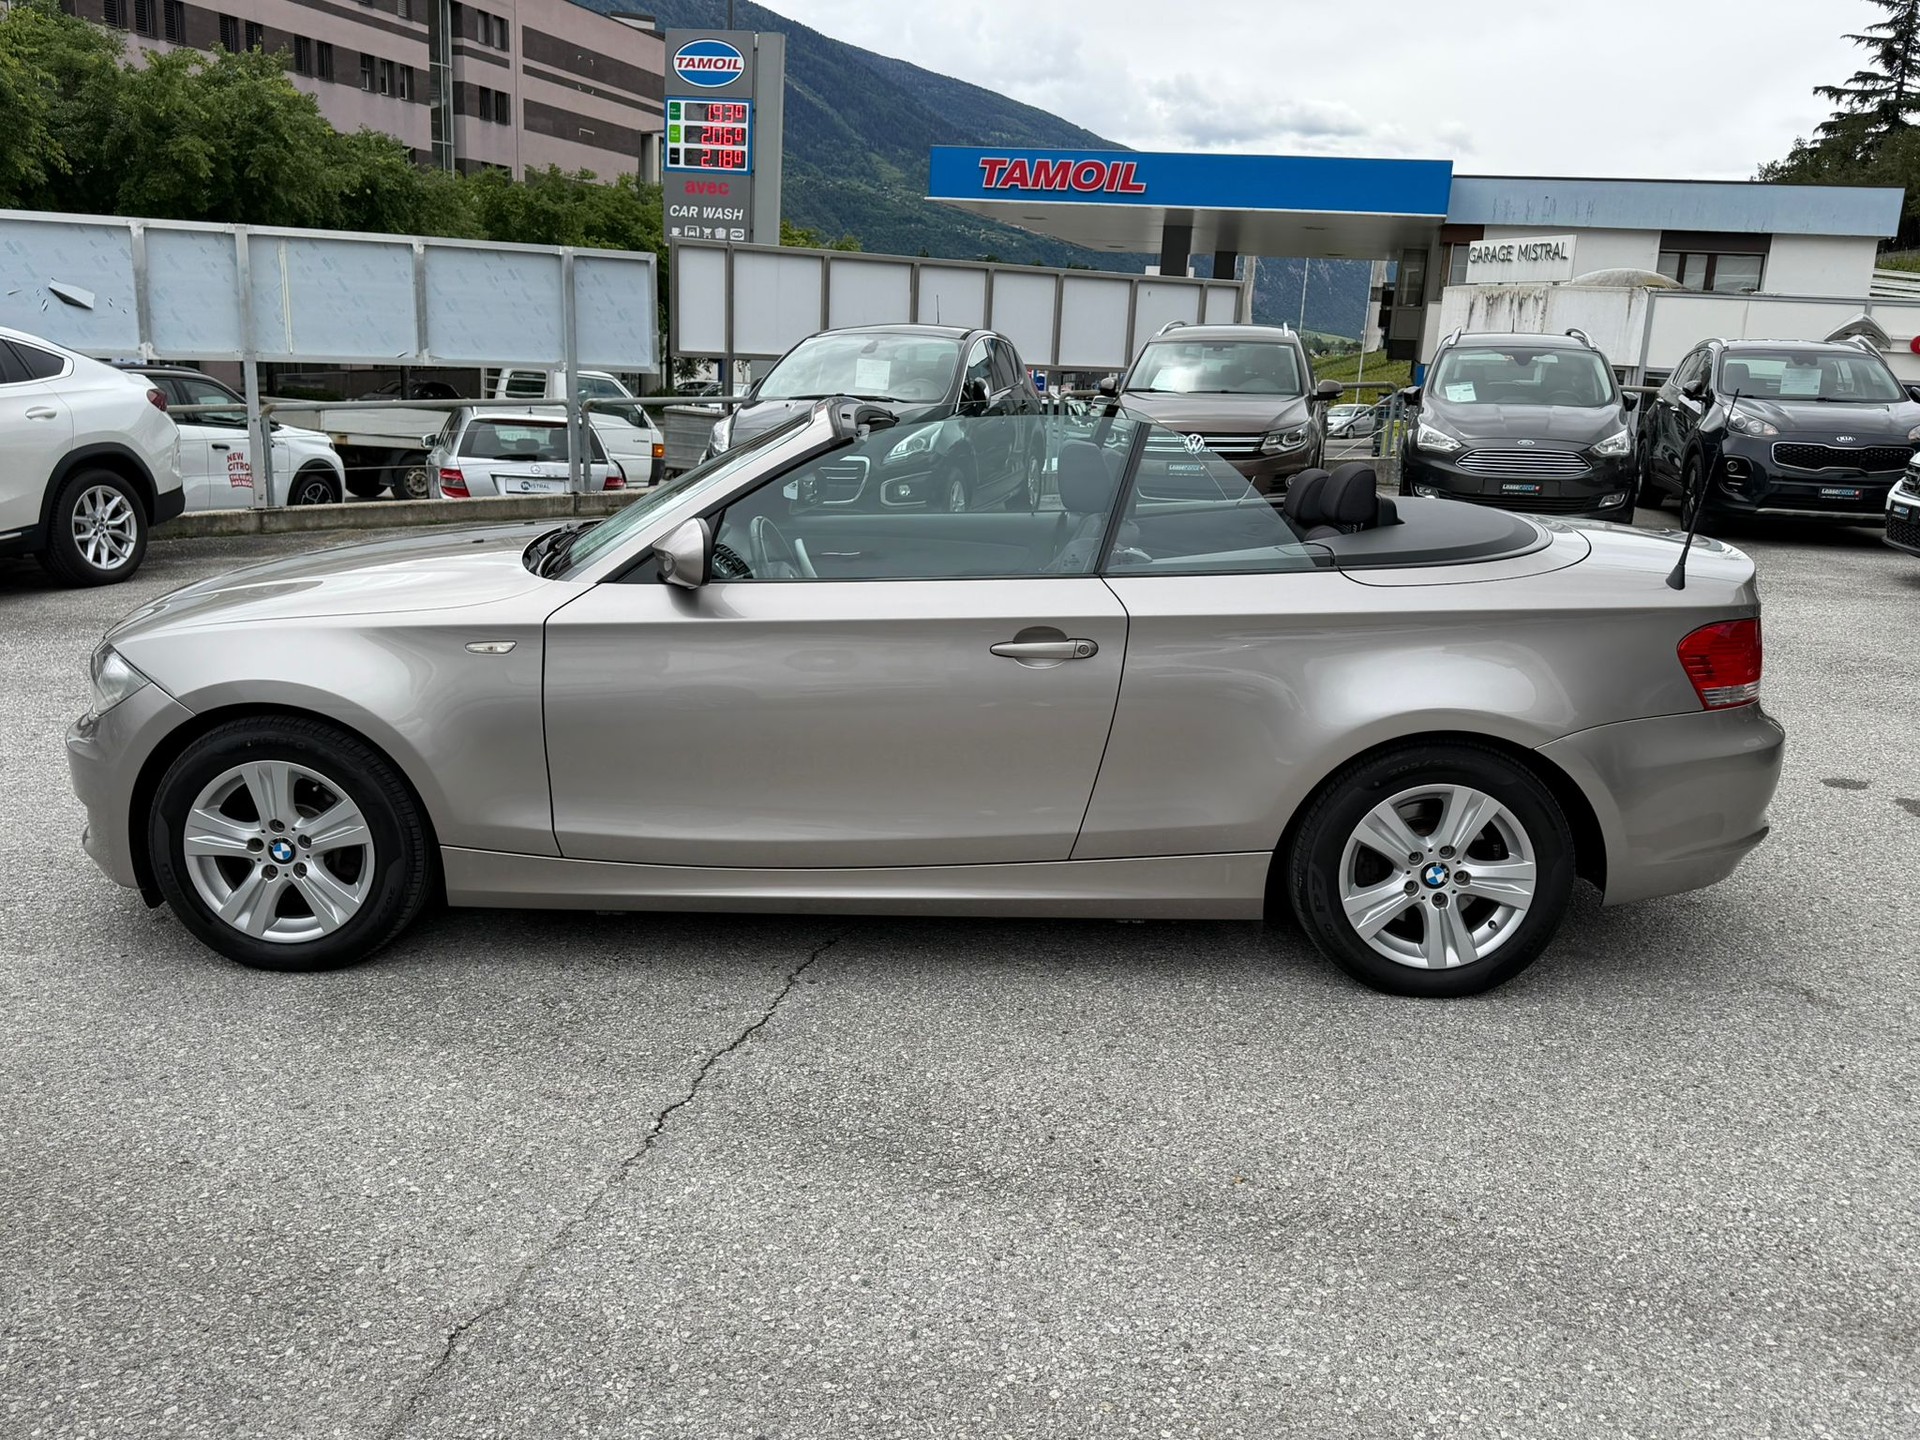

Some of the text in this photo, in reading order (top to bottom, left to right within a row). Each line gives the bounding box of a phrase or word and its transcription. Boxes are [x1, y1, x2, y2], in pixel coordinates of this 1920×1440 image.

[676, 56, 742, 70] TAMOIL
[979, 157, 1147, 193] TAMOIL
[685, 180, 730, 195] avec
[669, 205, 744, 221] CAR WASH
[1469, 242, 1569, 264] GARAGE MISTRAL
[227, 453, 244, 463] NEW
[228, 461, 252, 472] CITRO
